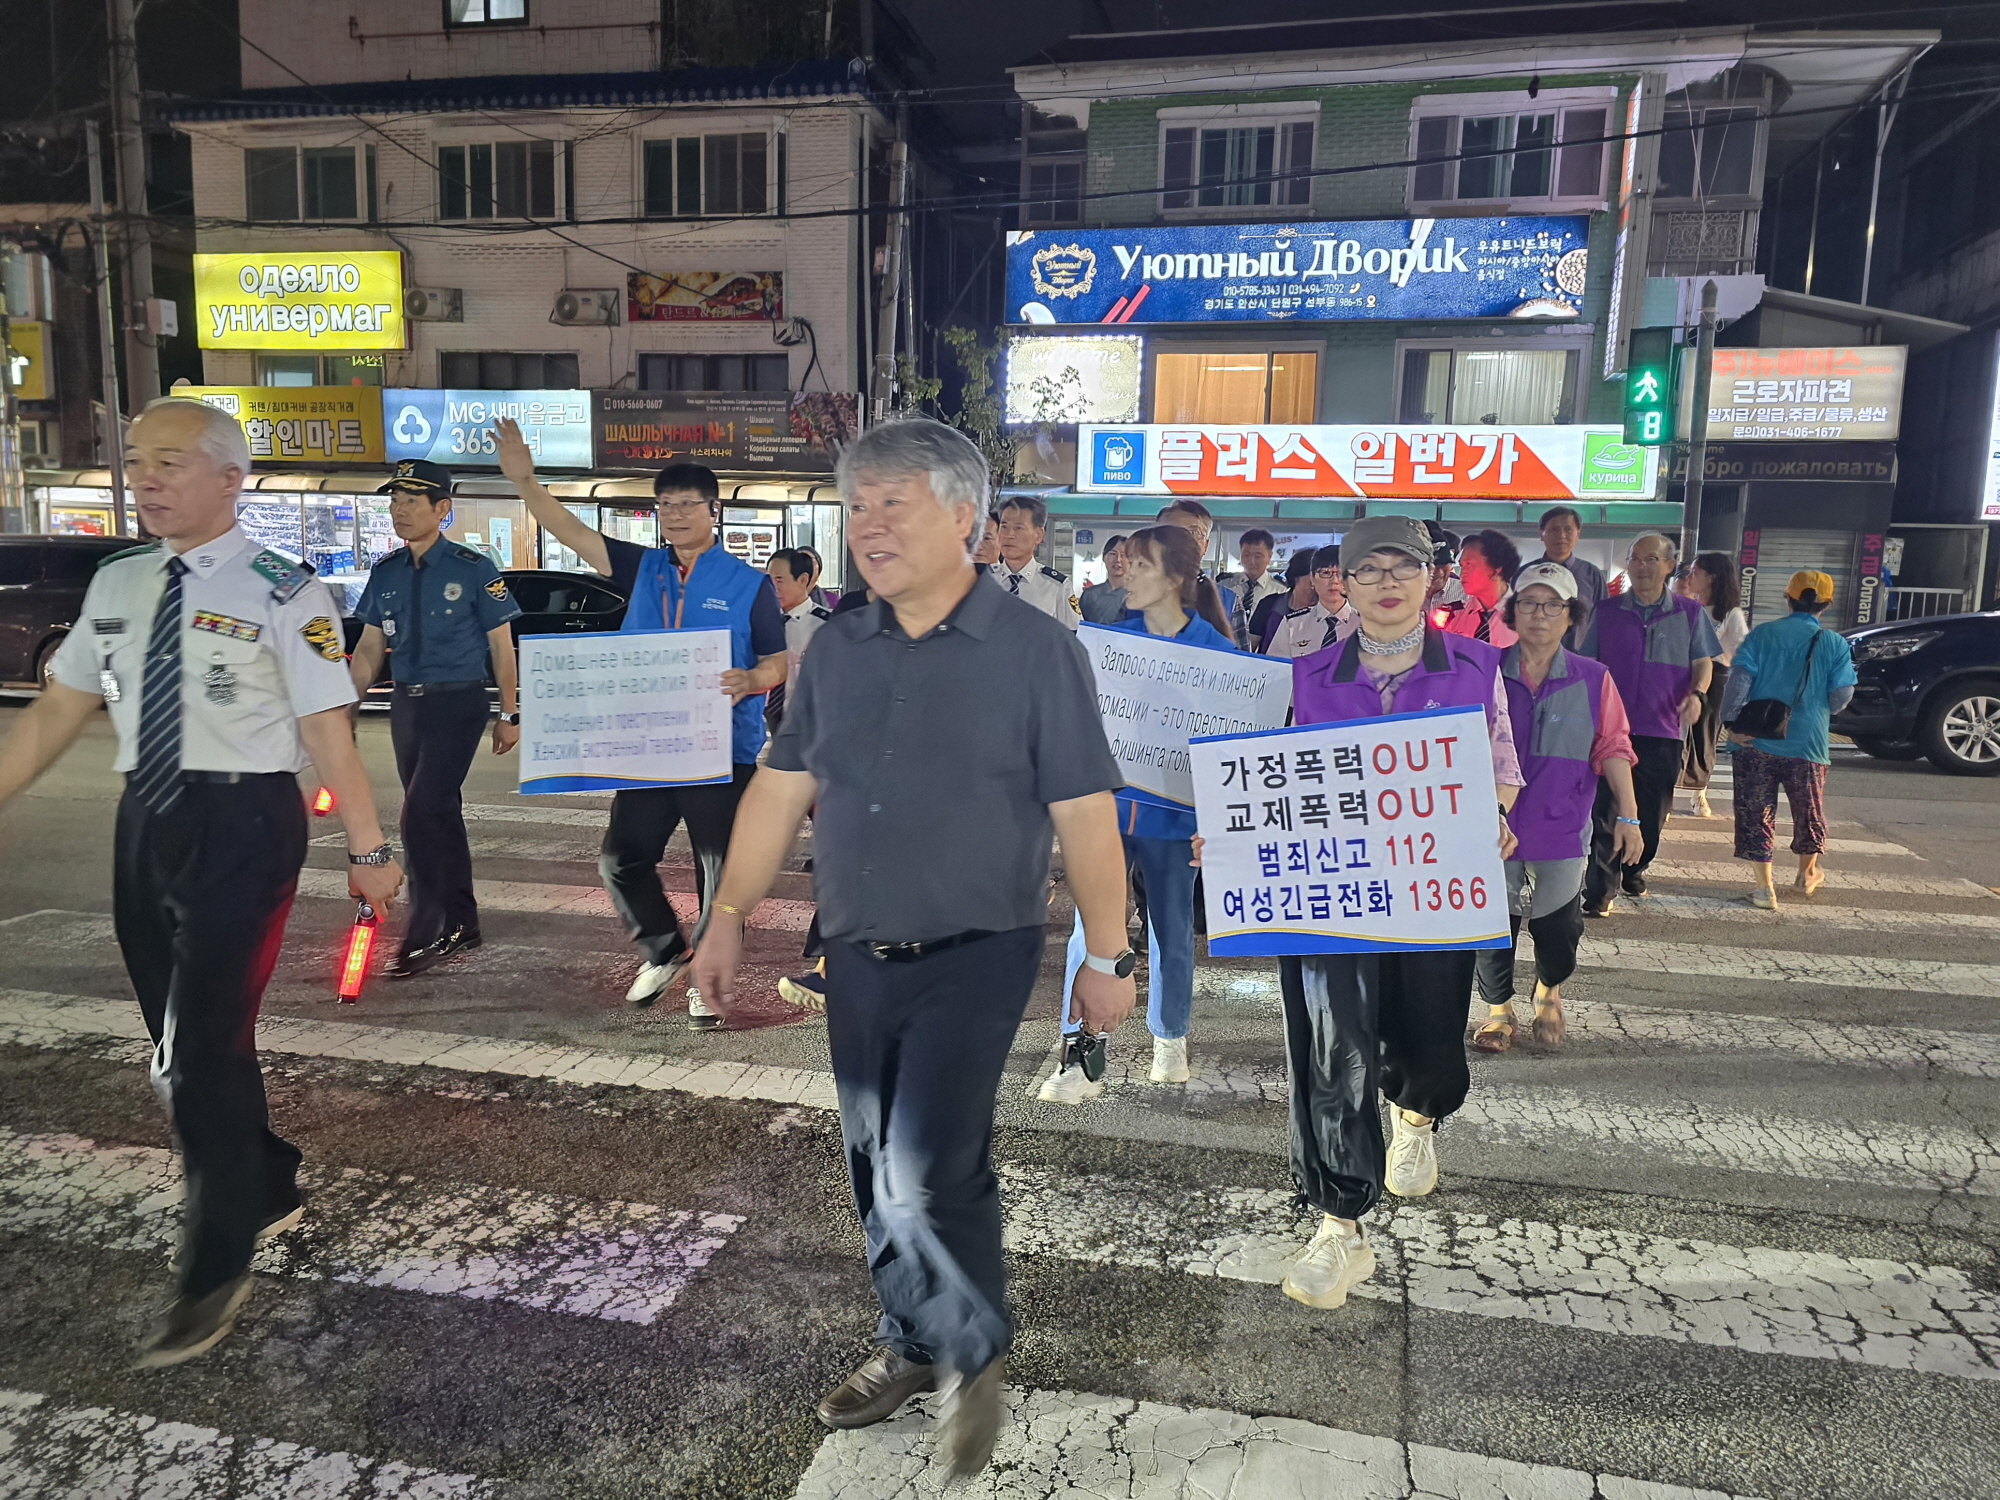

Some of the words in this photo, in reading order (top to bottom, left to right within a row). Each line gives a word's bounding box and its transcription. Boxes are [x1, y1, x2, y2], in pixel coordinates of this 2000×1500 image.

[1112, 239, 1298, 281] Уютный
[1302, 232, 1469, 287] Дворик
[1477, 269, 1505, 281] 음식점
[239, 264, 360, 298] одеяло
[1223, 286, 1281, 296] 010-5785-3343
[1288, 284, 1345, 295] 031-494-7092
[1204, 299, 1235, 310] 경기도
[1238, 299, 1268, 309] 안산시
[1271, 298, 1302, 309] 단원구
[210, 303, 391, 337] универмаг
[310, 401, 354, 413] 공장직거래
[612, 399, 663, 410] 010-5660-0607
[1732, 379, 1852, 404] 근로자파견
[449, 402, 486, 424] MG
[1644, 411, 1660, 439] 8
[245, 418, 365, 456] 할인마트
[451, 428, 496, 455] 365
[605, 424, 703, 443] ШАШЛЫЧНАЯ
[1159, 431, 1315, 482] 플러스
[1351, 432, 1519, 485] 일번가
[1672, 456, 1744, 478] Дбро
[1752, 460, 1888, 478] пожаловать
[1589, 474, 1637, 488] курица
[1740, 567, 1757, 608] Оплата
[1857, 576, 1878, 624] Оплата
[1101, 644, 1145, 678] Запрос
[1148, 659, 1156, 679] о
[1156, 660, 1207, 689] деньгах
[1209, 669, 1217, 691] и
[1218, 672, 1267, 700] личной
[1160, 705, 1184, 730] это
[1111, 733, 1166, 768] фишинга
[1221, 743, 1364, 792] 가정폭력
[1372, 736, 1459, 775] OUT
[1225, 789, 1370, 833] 교제폭력
[1377, 783, 1463, 821] OUT
[1258, 837, 1371, 878] 범죄신고
[1386, 832, 1438, 866] 112
[1223, 879, 1393, 924] 여성긴급전화
[1409, 876, 1488, 912] 1366
